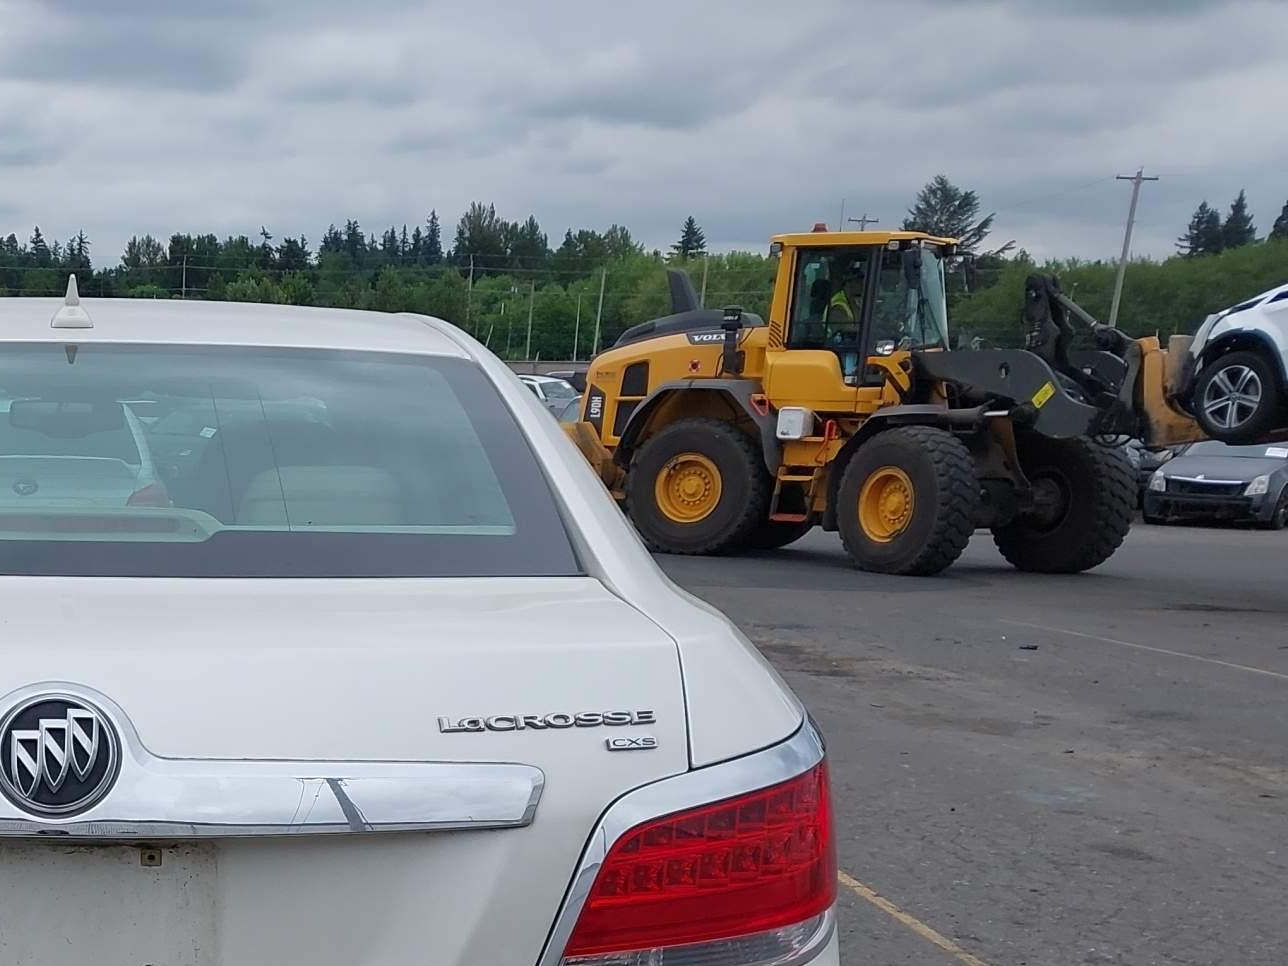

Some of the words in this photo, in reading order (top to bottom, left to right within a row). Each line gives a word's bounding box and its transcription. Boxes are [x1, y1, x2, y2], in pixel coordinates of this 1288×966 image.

[692, 333, 739, 342] VOLV
[590, 396, 603, 418] L90H
[612, 737, 656, 747] CXS
